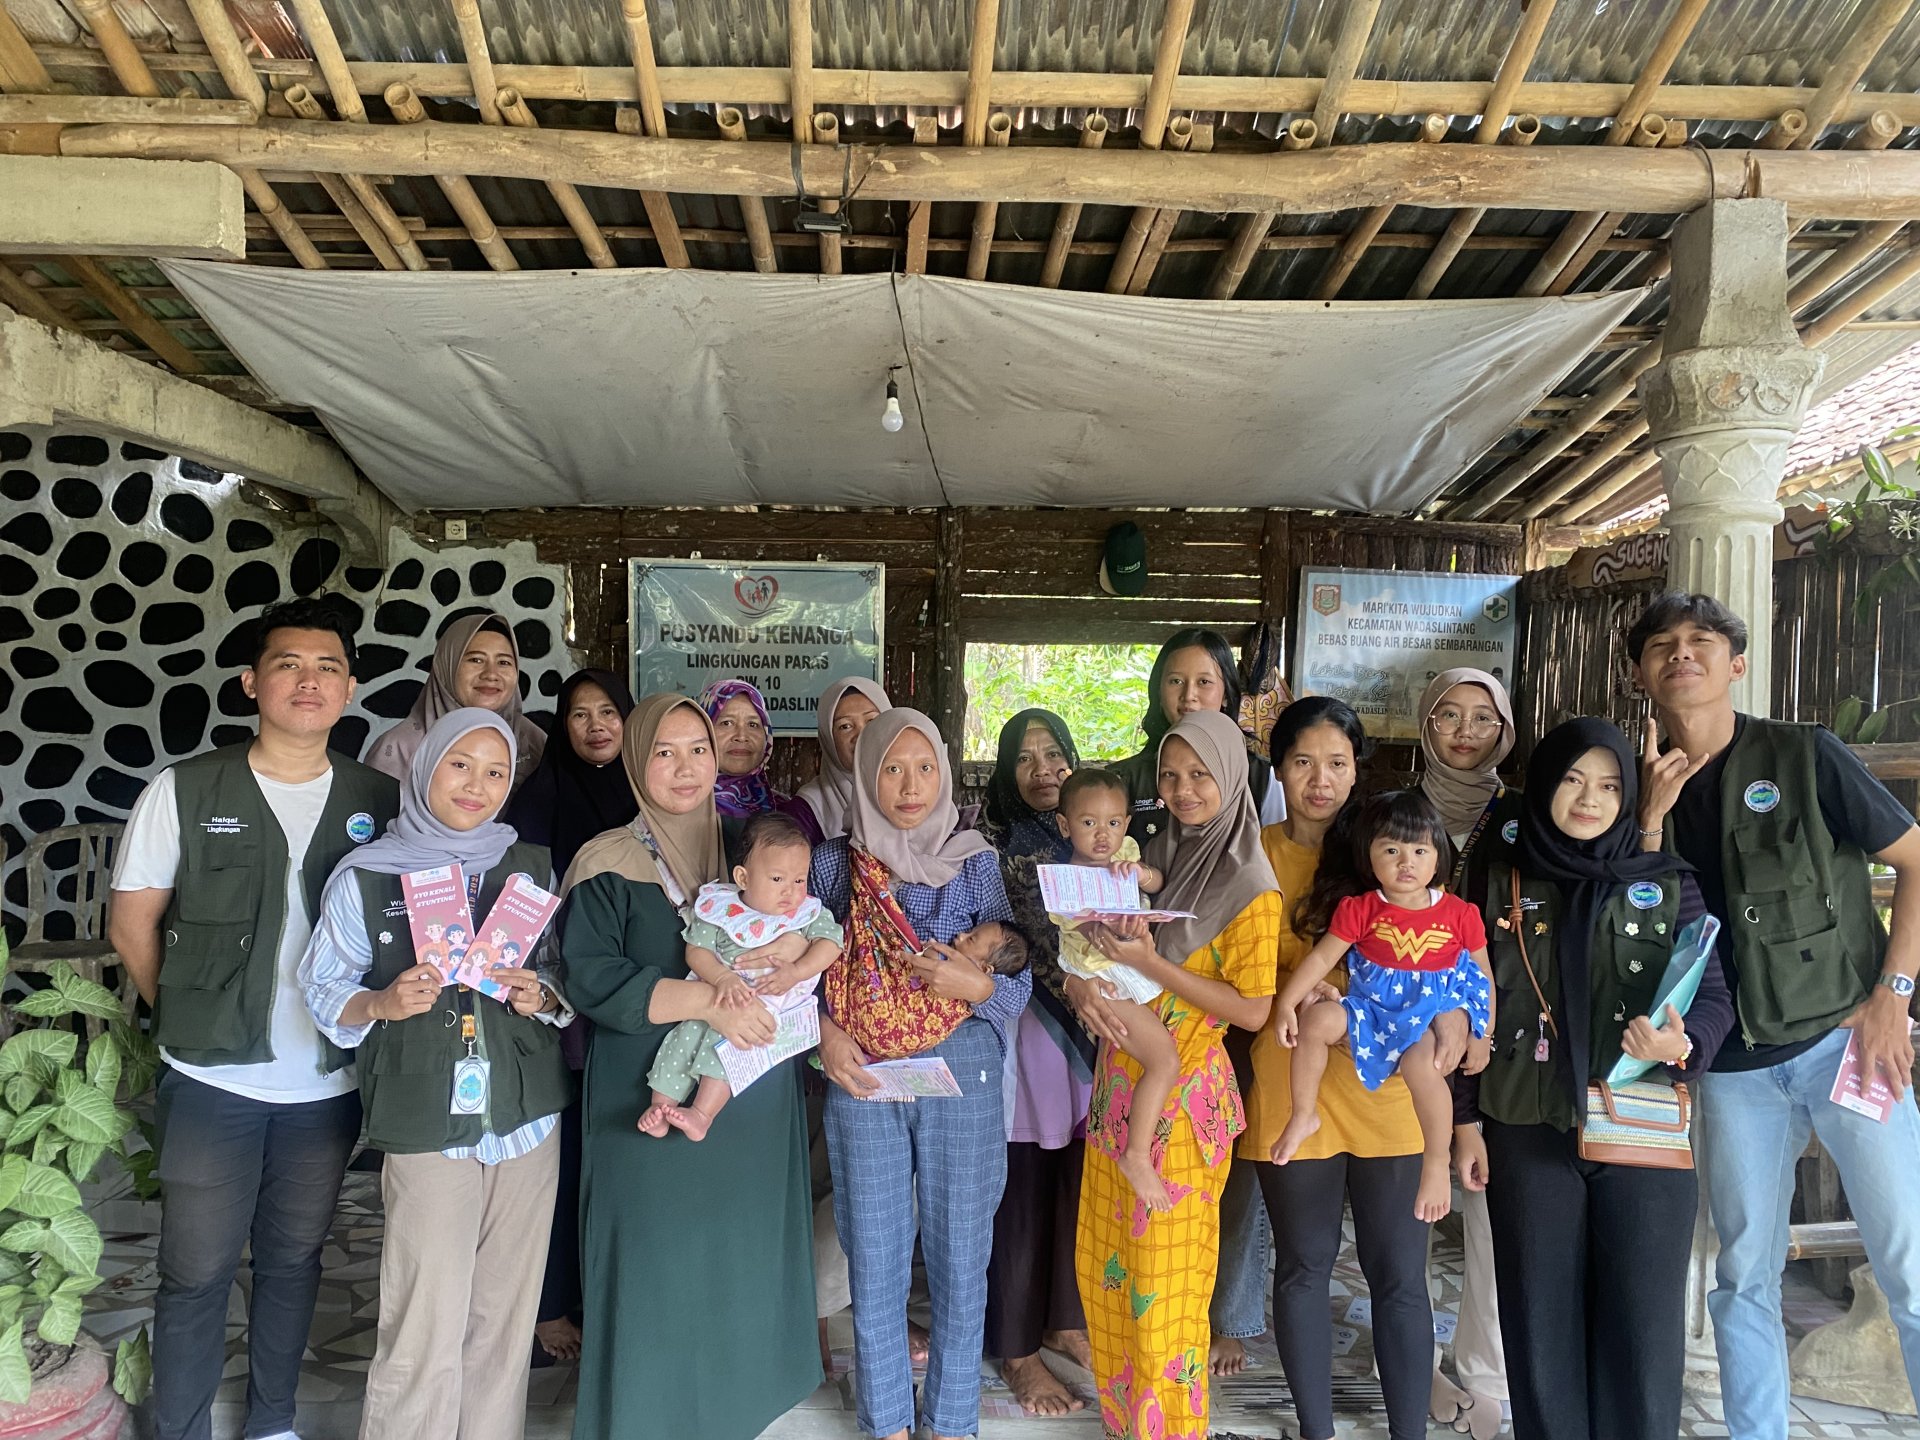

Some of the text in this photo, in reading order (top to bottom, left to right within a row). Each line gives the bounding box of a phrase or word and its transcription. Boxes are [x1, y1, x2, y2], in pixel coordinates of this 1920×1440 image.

[1411, 603, 1462, 617] WUJUDKAN
[660, 623, 855, 645] POSYANDU KENANGA
[1347, 617, 1476, 635] KECAMATAN WADASLINTANG
[1318, 633, 1504, 653] BEBAS BUANG AIR BESAR SEMBARANGAN
[687, 654, 829, 670] LINGKUNGAN PARAS
[765, 675, 781, 690] 10
[764, 697, 819, 712] ADASLIN
[413, 885, 456, 900] AYO KENALI
[415, 894, 456, 908] STUNTING!
[505, 895, 543, 917] AYO KENALI
[502, 903, 538, 925] STUNTING!
